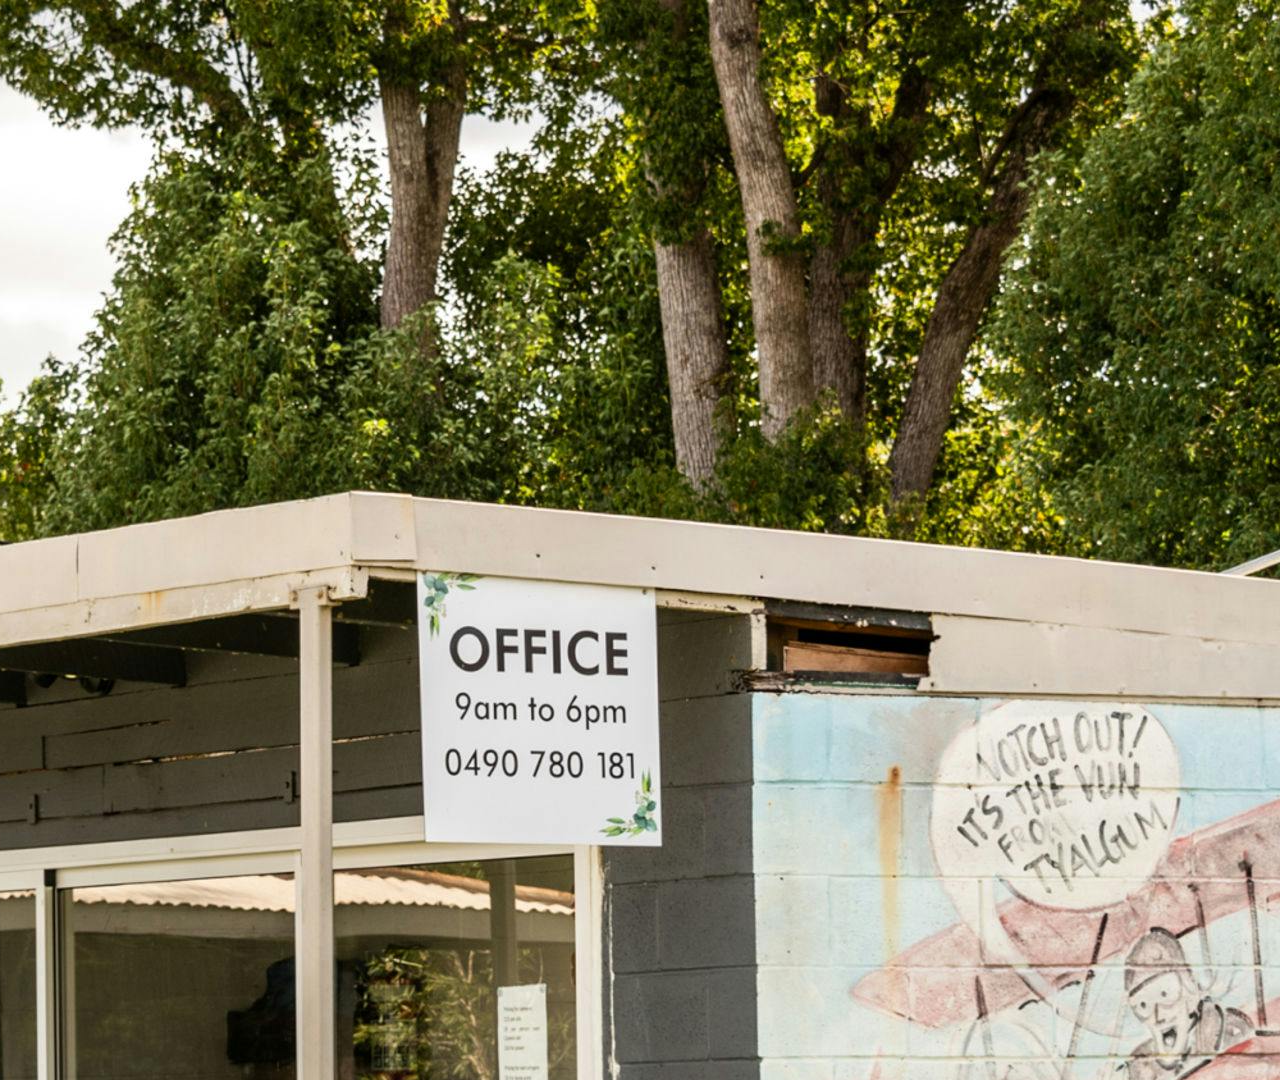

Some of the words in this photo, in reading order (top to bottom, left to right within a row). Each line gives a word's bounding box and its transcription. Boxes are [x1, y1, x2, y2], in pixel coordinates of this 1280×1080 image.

[449, 625, 629, 676] OFFICE
[455, 692, 517, 721] 9am
[528, 697, 554, 722] to
[566, 695, 627, 730] 6pm
[1073, 711, 1148, 758] OUT!
[445, 748, 519, 777] 0490
[530, 750, 584, 778] 780
[597, 752, 635, 779] 181
[957, 793, 1004, 847] IT'S
[1074, 760, 1141, 803] VUN
[1023, 801, 1168, 894] TYALGUM
